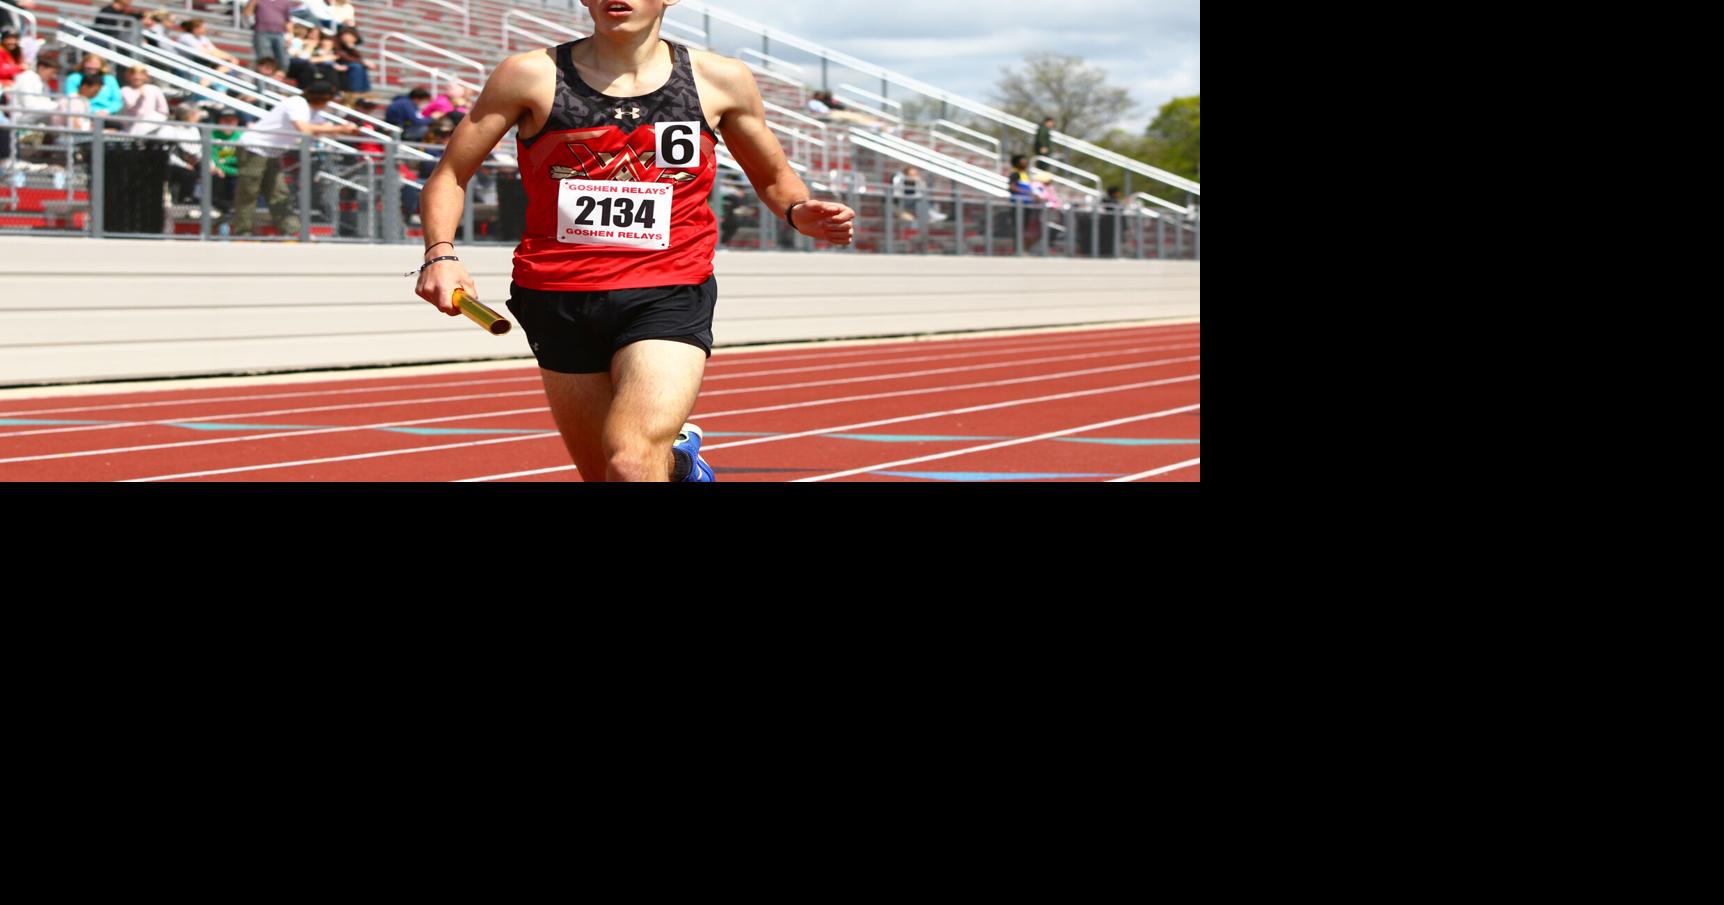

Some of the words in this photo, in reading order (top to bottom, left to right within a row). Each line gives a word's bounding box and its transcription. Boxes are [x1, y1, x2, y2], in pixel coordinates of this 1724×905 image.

[661, 125, 694, 165] 6
[568, 184, 619, 193] GOSHEN
[621, 186, 666, 195] RELAYS
[574, 195, 656, 229] 2134
[566, 228, 614, 238] GOSHEN
[617, 231, 662, 241] RELAYS
